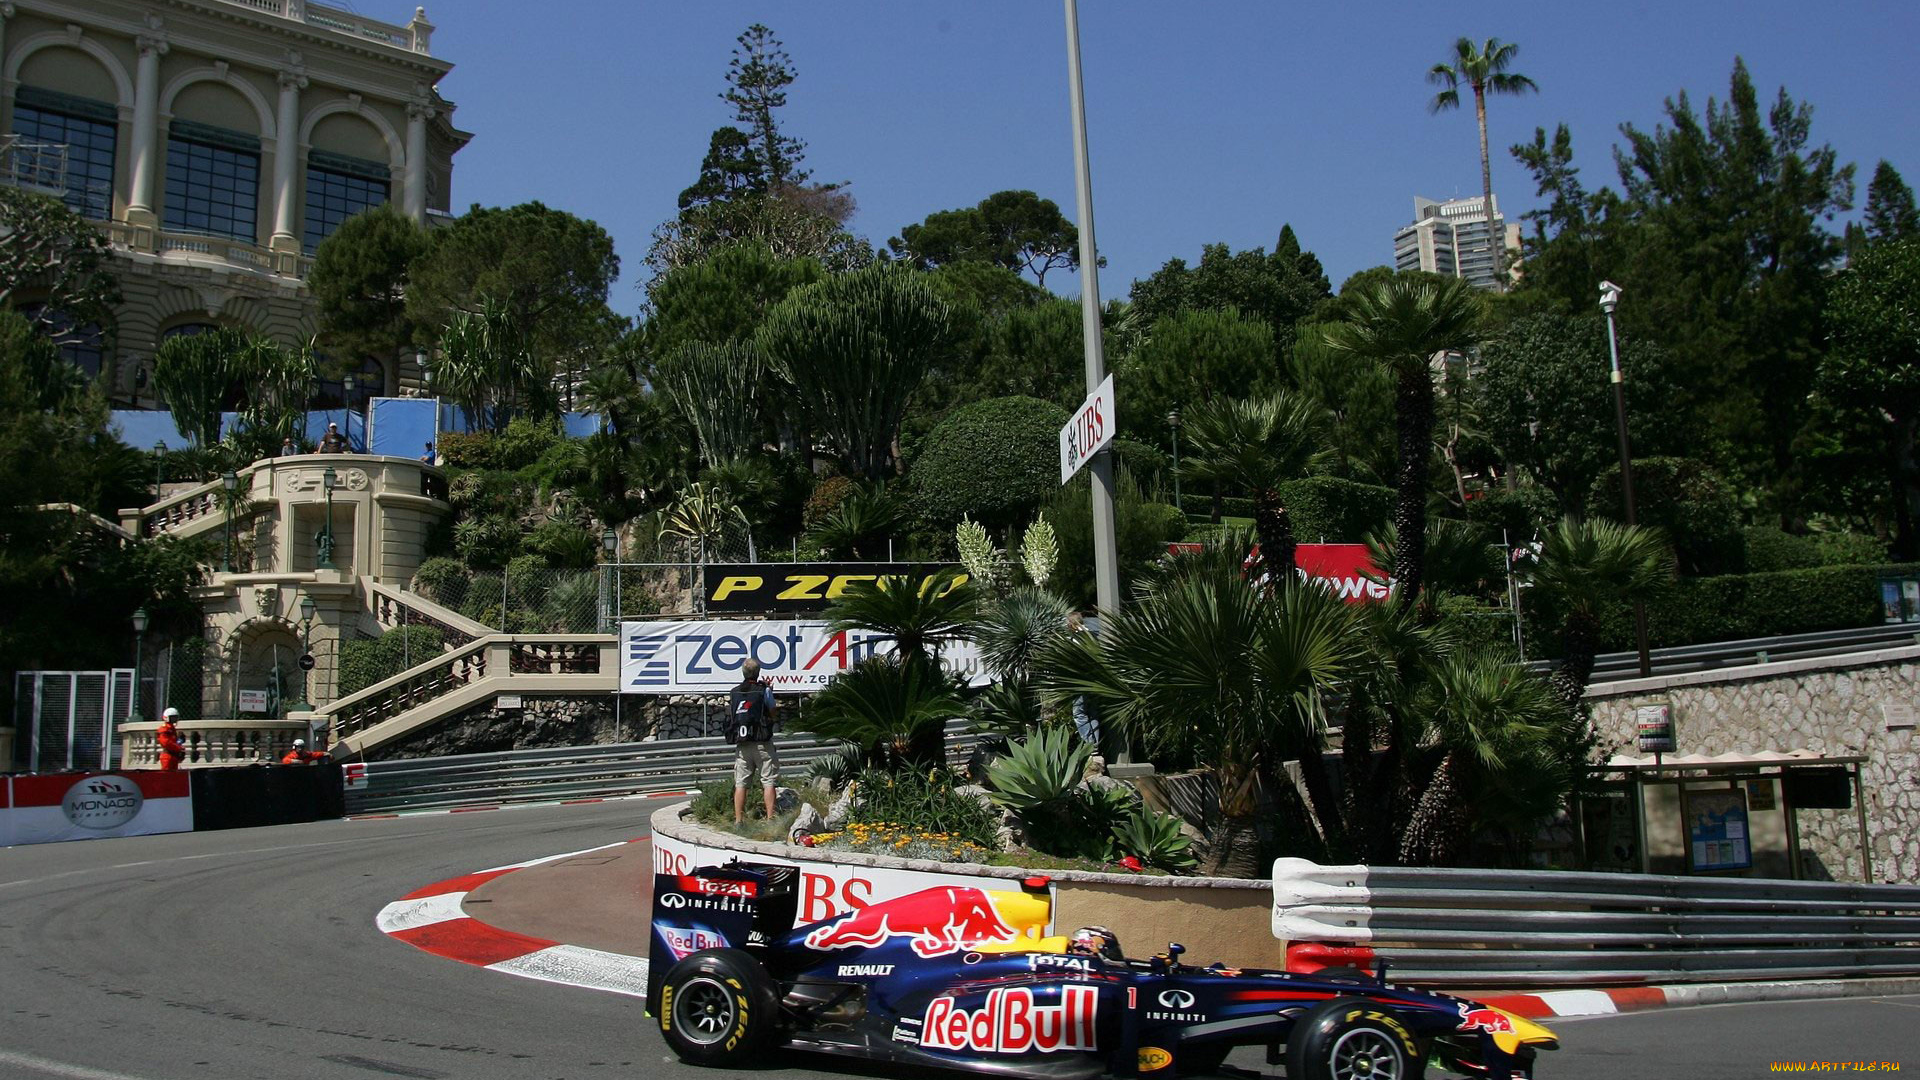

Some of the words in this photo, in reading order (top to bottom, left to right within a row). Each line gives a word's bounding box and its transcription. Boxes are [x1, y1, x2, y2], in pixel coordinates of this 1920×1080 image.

[1077, 397, 1104, 458] UBS
[712, 576, 763, 601] P
[71, 798, 137, 811] MONACO
[696, 877, 752, 896] TOTAL
[688, 899, 752, 913] INFINITI
[799, 872, 872, 923] BS
[837, 964, 895, 977] RENAULT
[1025, 953, 1097, 972] TOTAL
[1127, 986, 1137, 1010] 1
[1146, 1011, 1206, 1022] INFINITI
